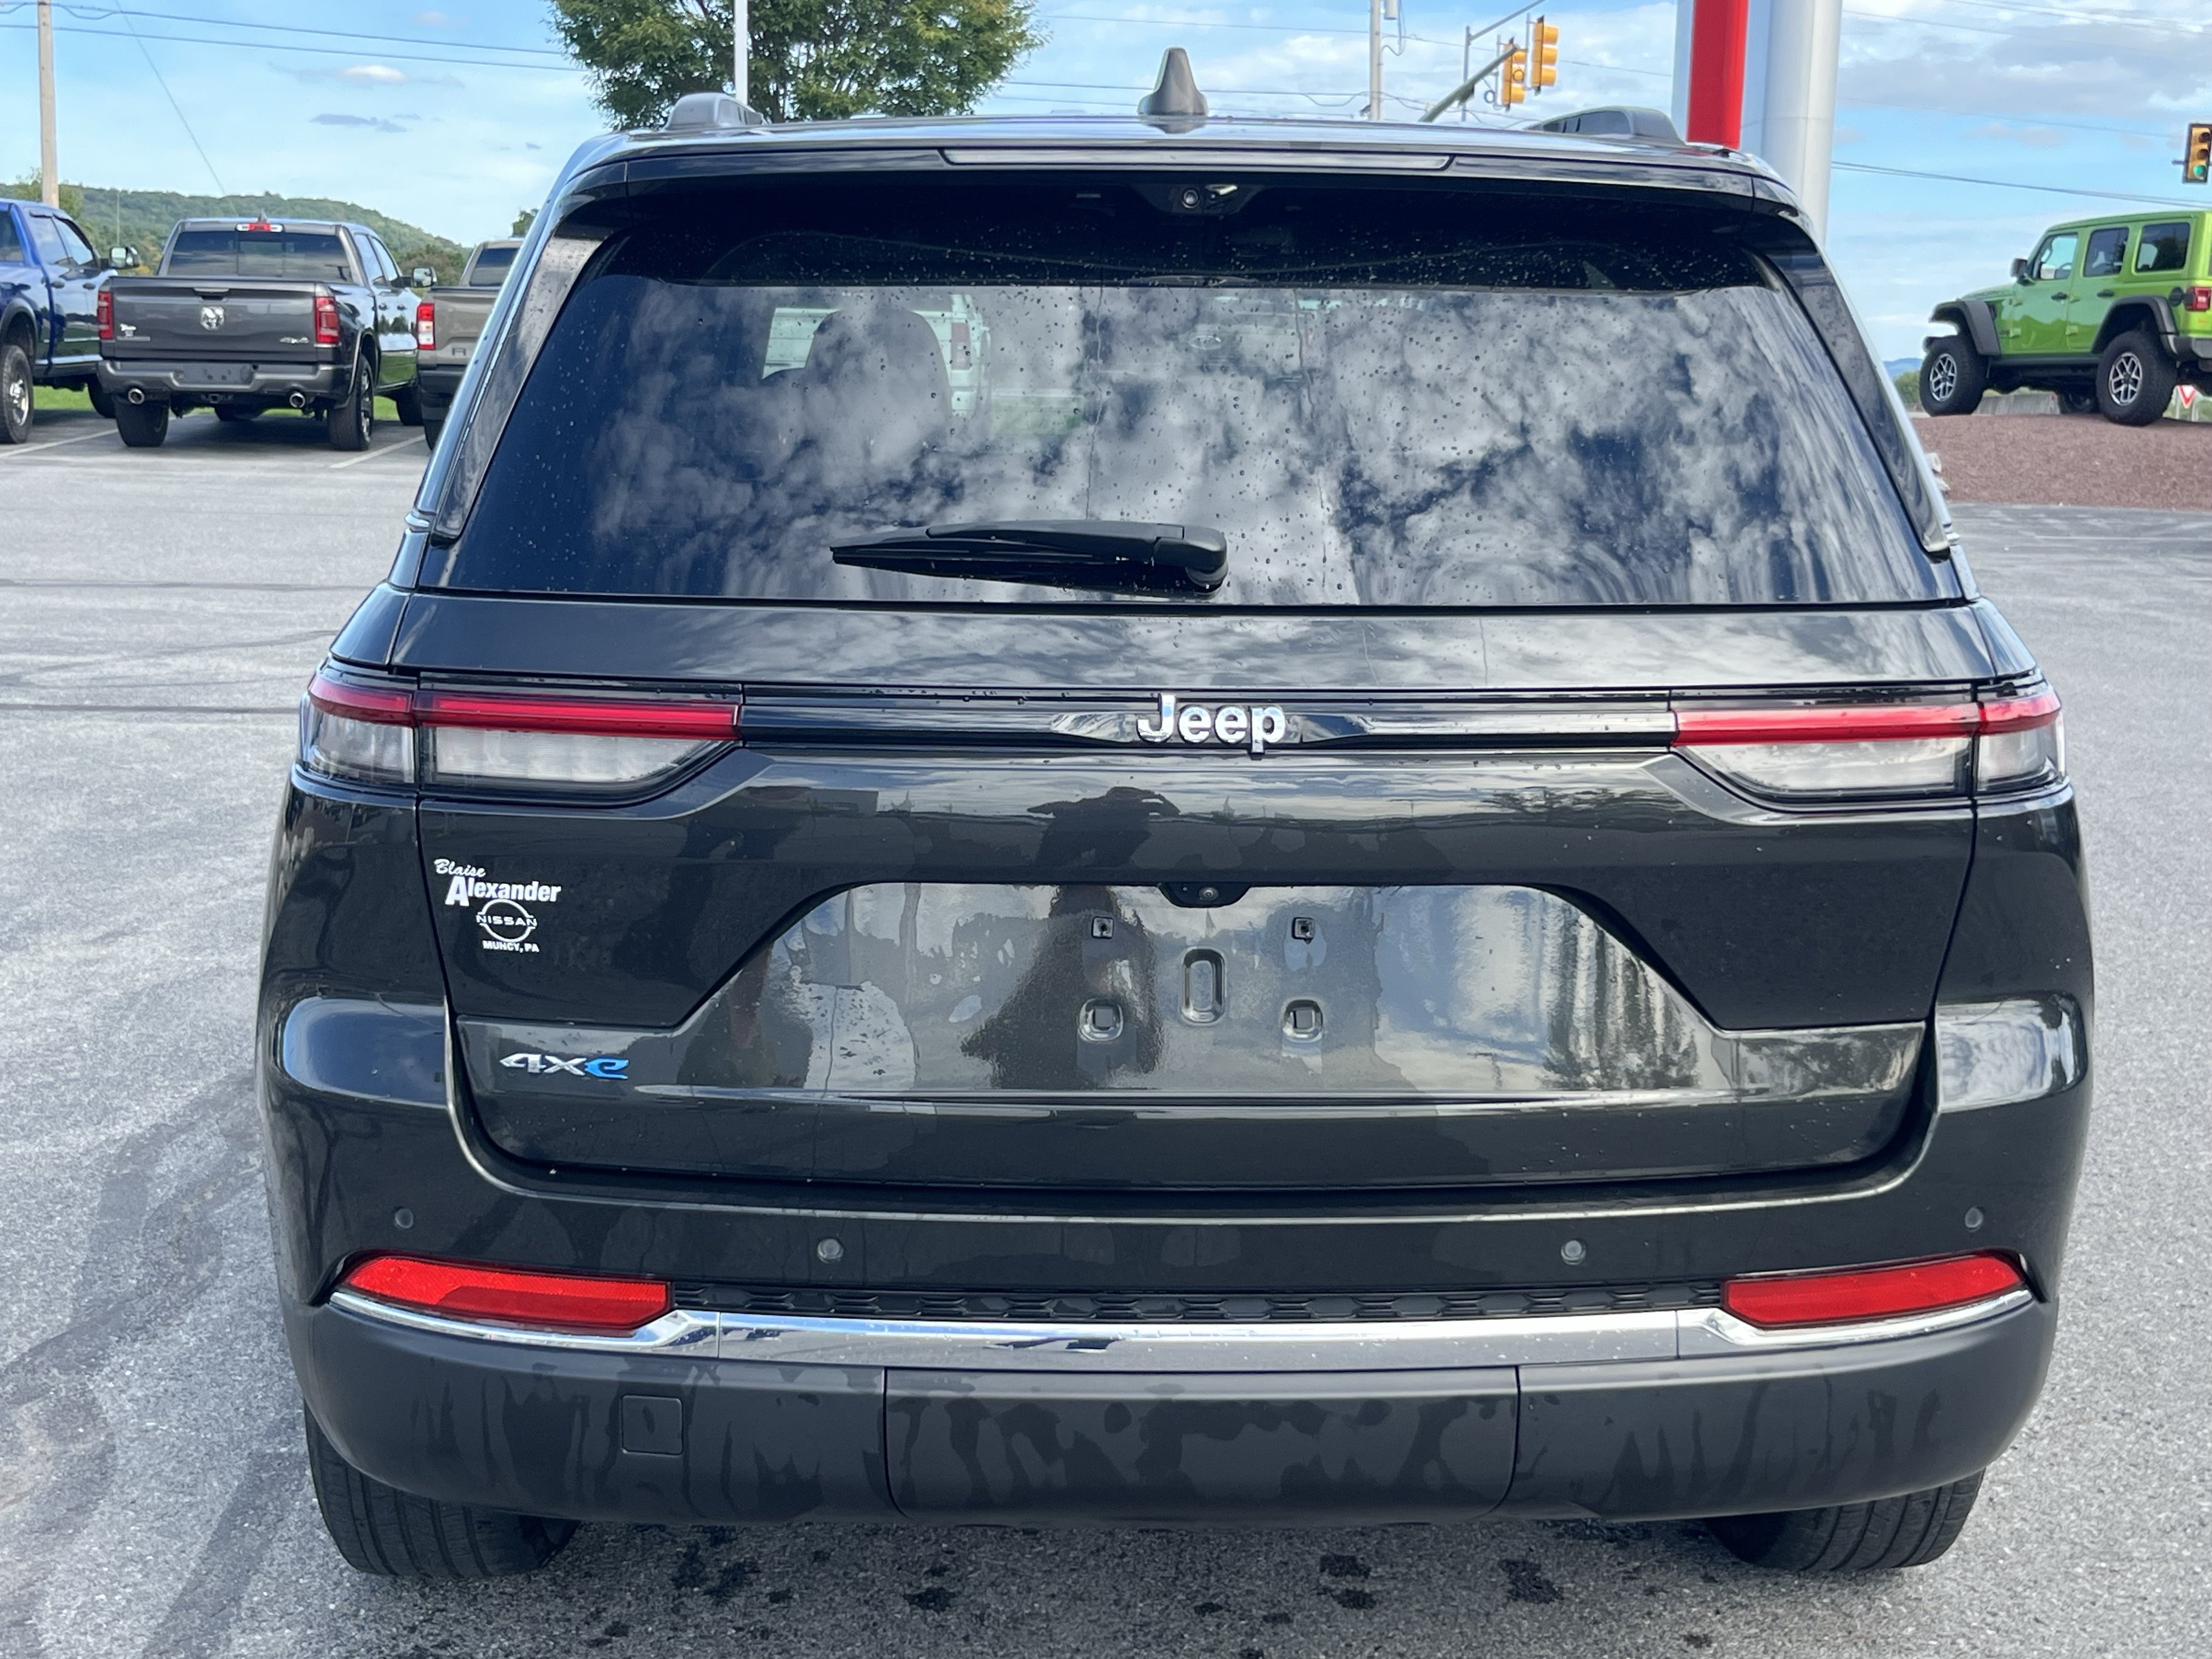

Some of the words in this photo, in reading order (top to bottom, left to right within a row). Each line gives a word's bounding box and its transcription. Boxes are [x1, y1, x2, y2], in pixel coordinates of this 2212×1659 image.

[1135, 693, 1288, 754] Jeep
[433, 858, 486, 878] Blaise
[445, 876, 561, 906] Alexander
[475, 913, 538, 927] NISSAN
